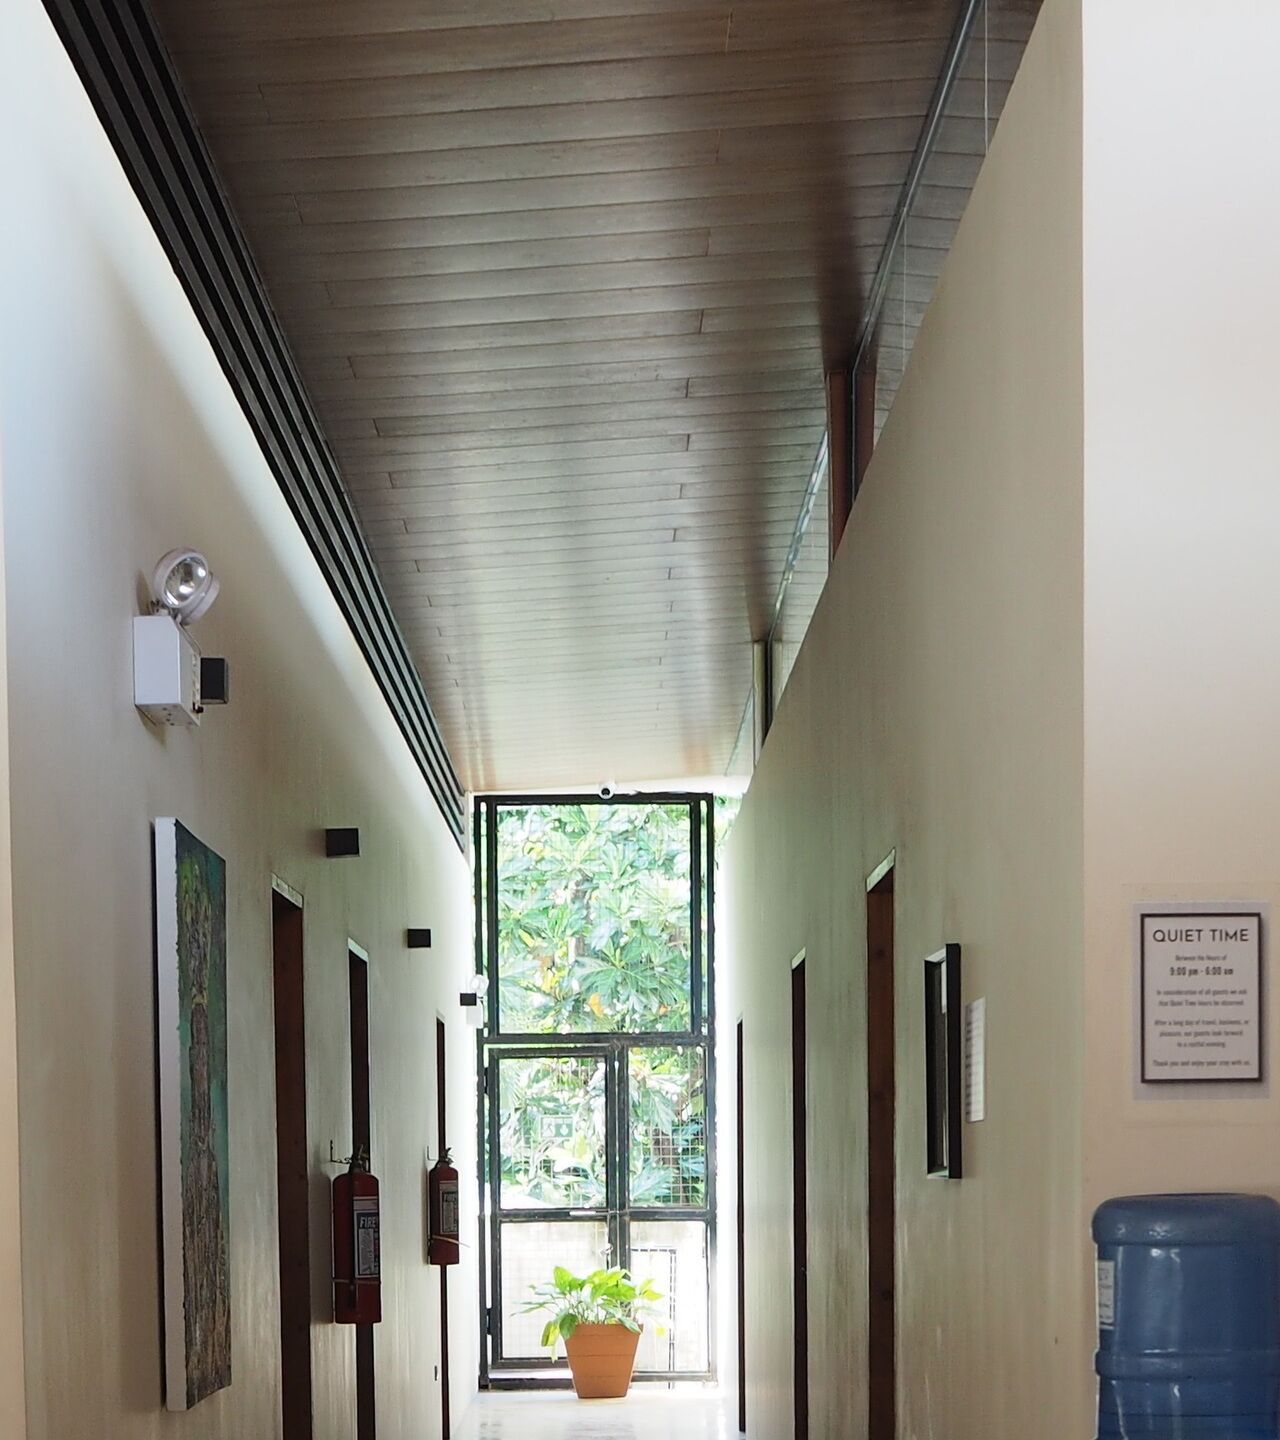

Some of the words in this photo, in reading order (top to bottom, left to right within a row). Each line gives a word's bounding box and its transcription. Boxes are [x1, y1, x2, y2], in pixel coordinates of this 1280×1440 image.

[1152, 929, 1204, 943] QUIET
[1210, 928, 1249, 942] TIME
[1188, 968, 1198, 977] pm
[1205, 966, 1221, 976] 6:00
